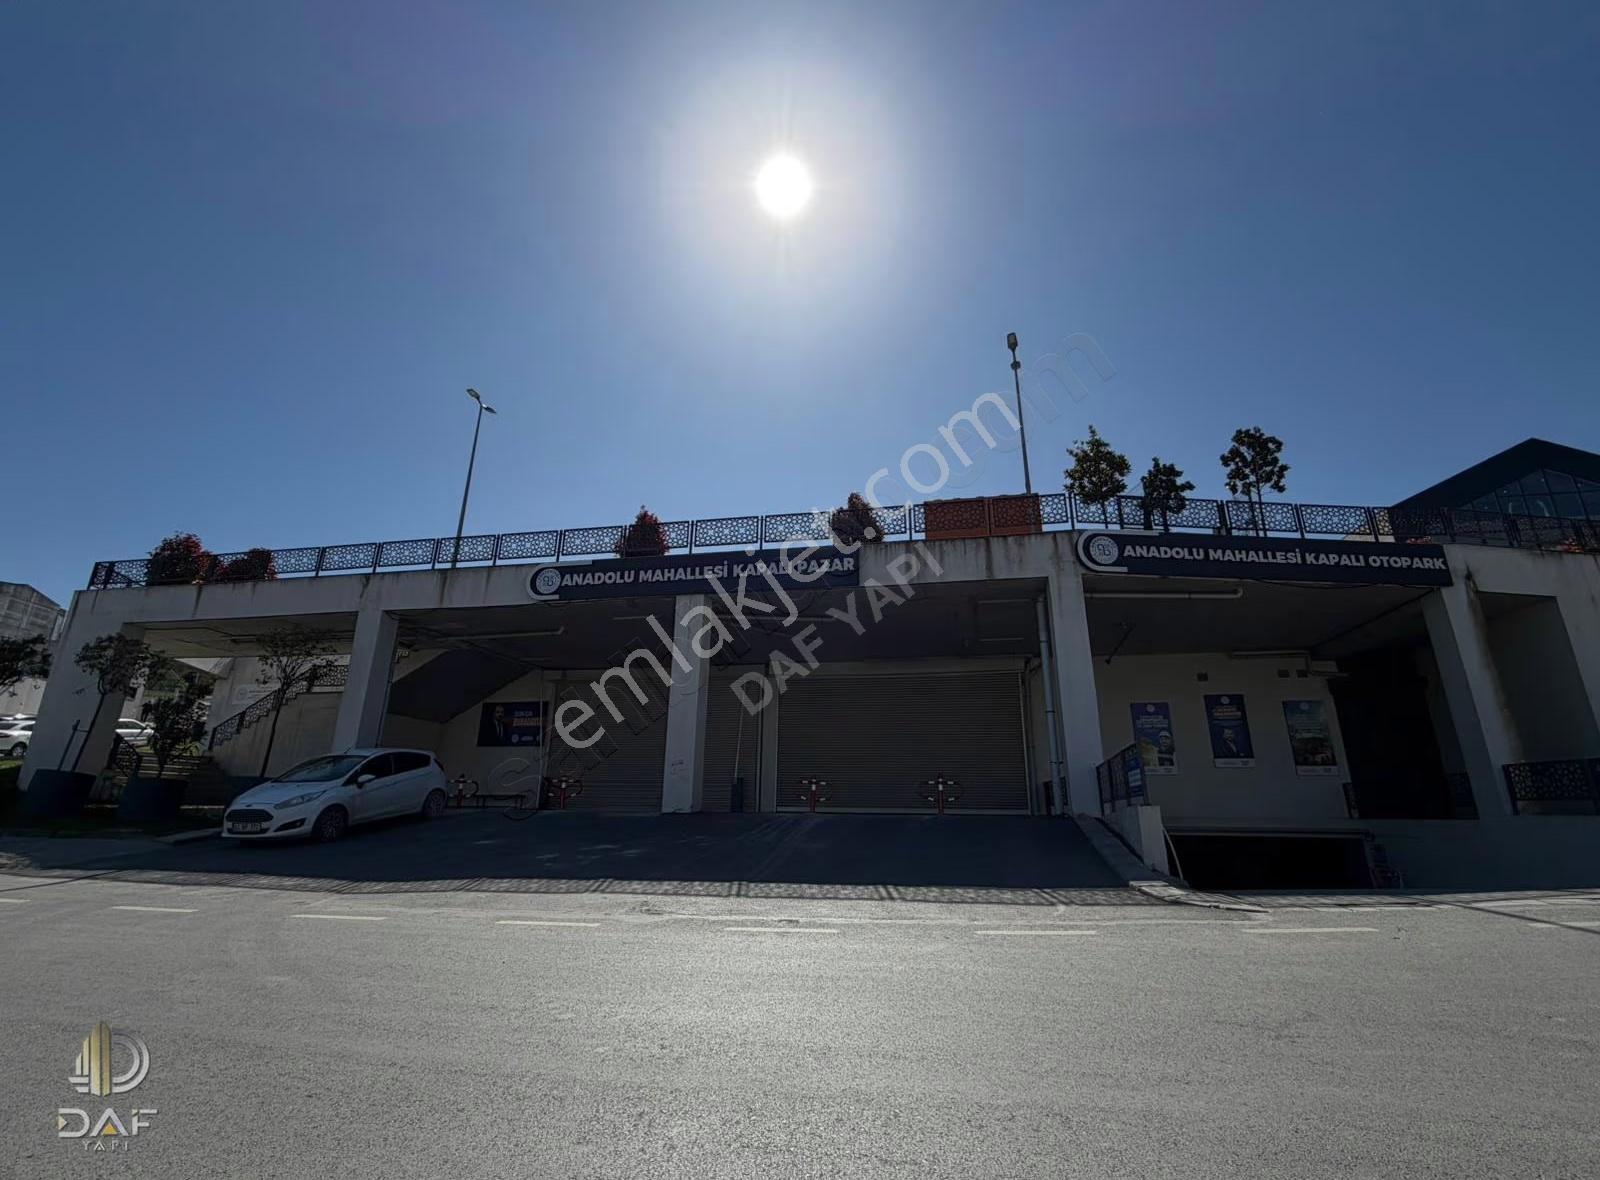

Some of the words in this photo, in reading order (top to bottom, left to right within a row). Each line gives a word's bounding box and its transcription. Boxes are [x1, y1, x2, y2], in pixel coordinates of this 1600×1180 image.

[1123, 545, 1205, 561] ANADOLU
[1208, 549, 1302, 565] MAHALLESİ
[1305, 552, 1365, 567] KAPALI
[1368, 555, 1448, 570] OTOPARK
[561, 570, 634, 587] ANADOLU
[639, 560, 729, 582] MAHALLESİ
